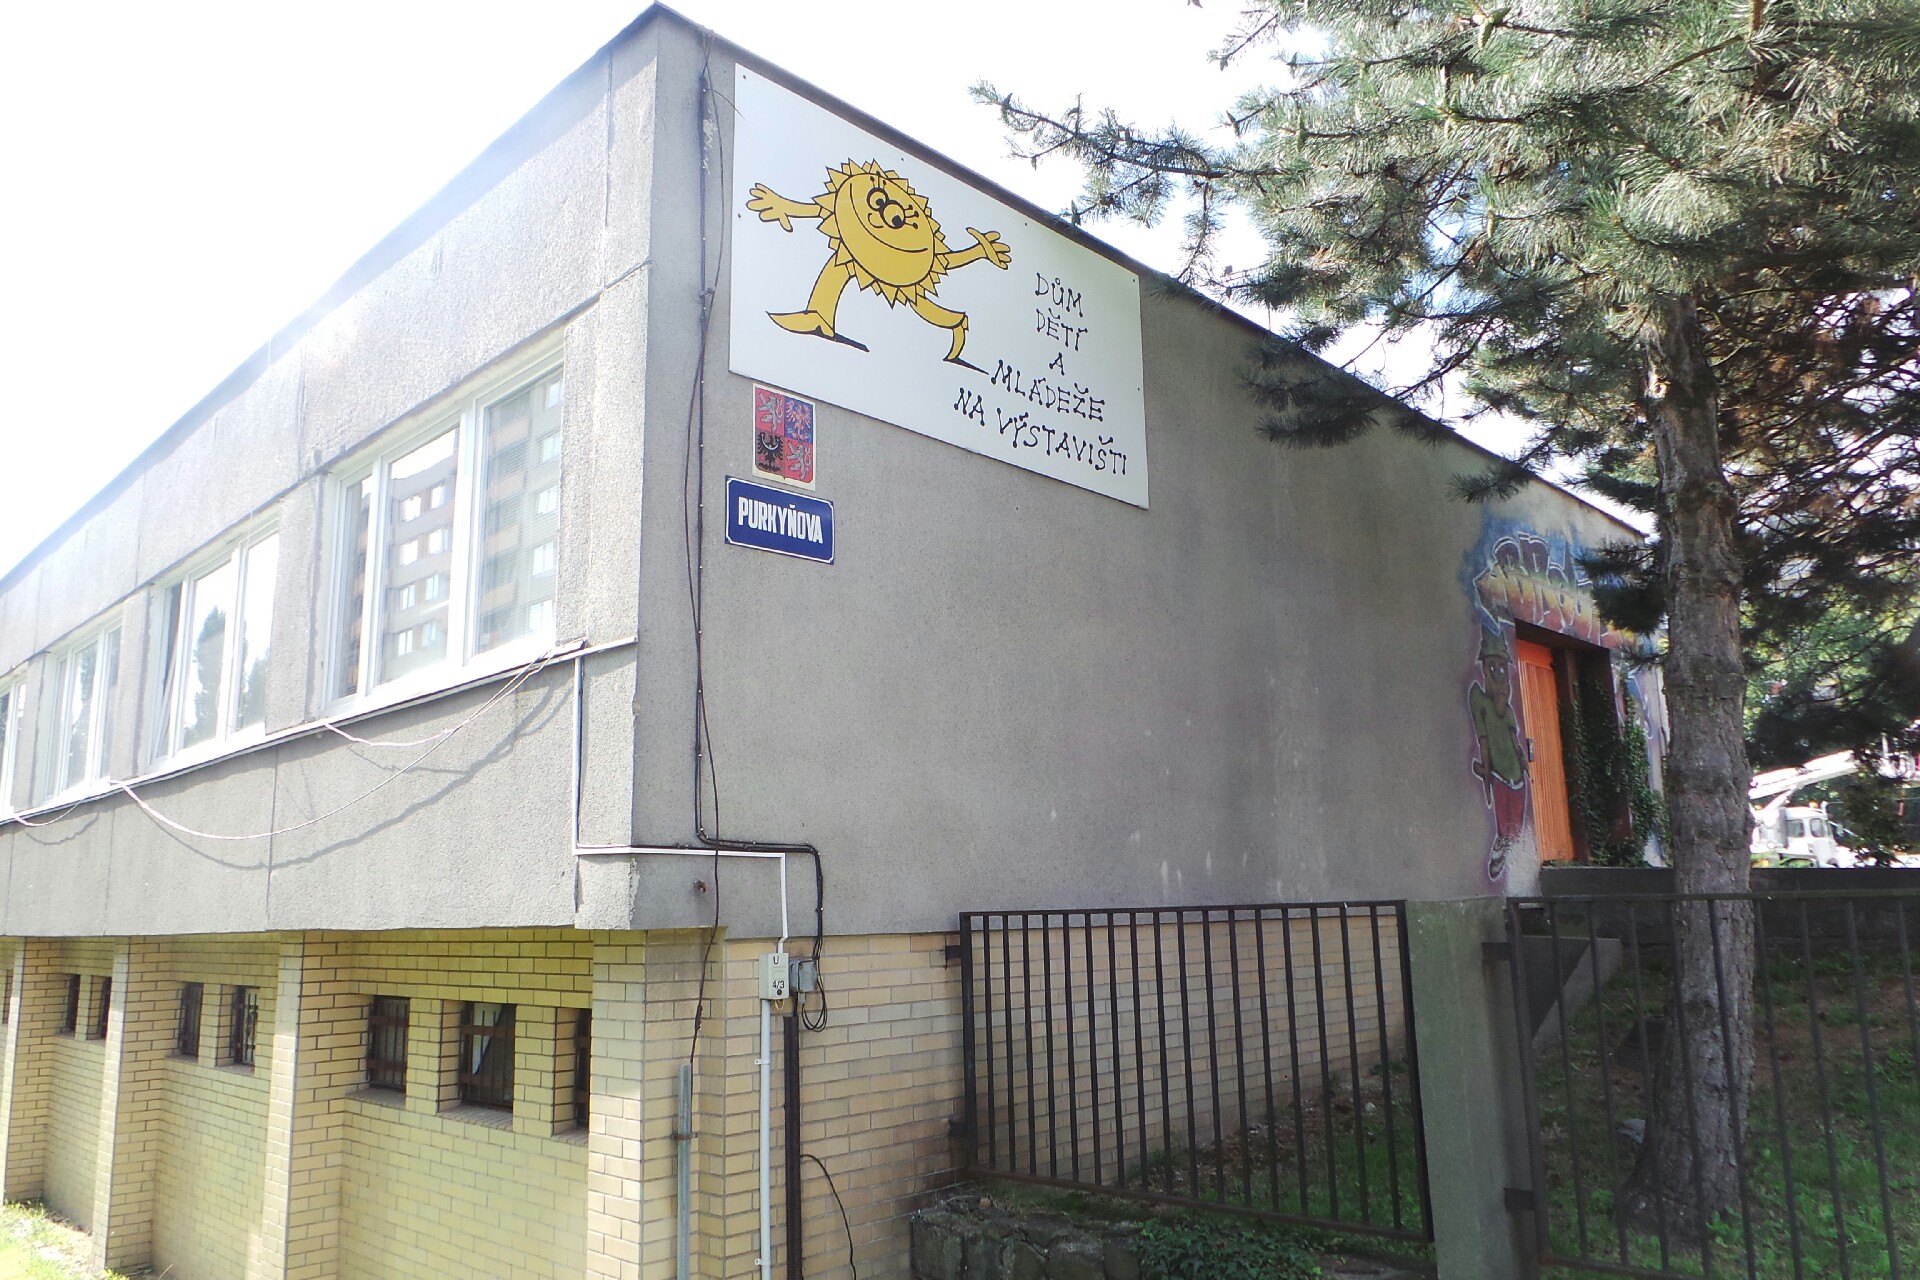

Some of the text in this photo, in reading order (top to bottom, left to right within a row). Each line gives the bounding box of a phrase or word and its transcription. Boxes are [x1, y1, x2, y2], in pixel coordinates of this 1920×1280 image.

[1035, 272, 1083, 318] DŮM
[1036, 307, 1088, 351] DĚTÍ
[1049, 352, 1065, 376] A
[990, 359, 1106, 422] MLÁDEŽE
[954, 387, 1128, 475] NA VÝSTAVIŠTI
[738, 496, 823, 544] PURKYŇOVA
